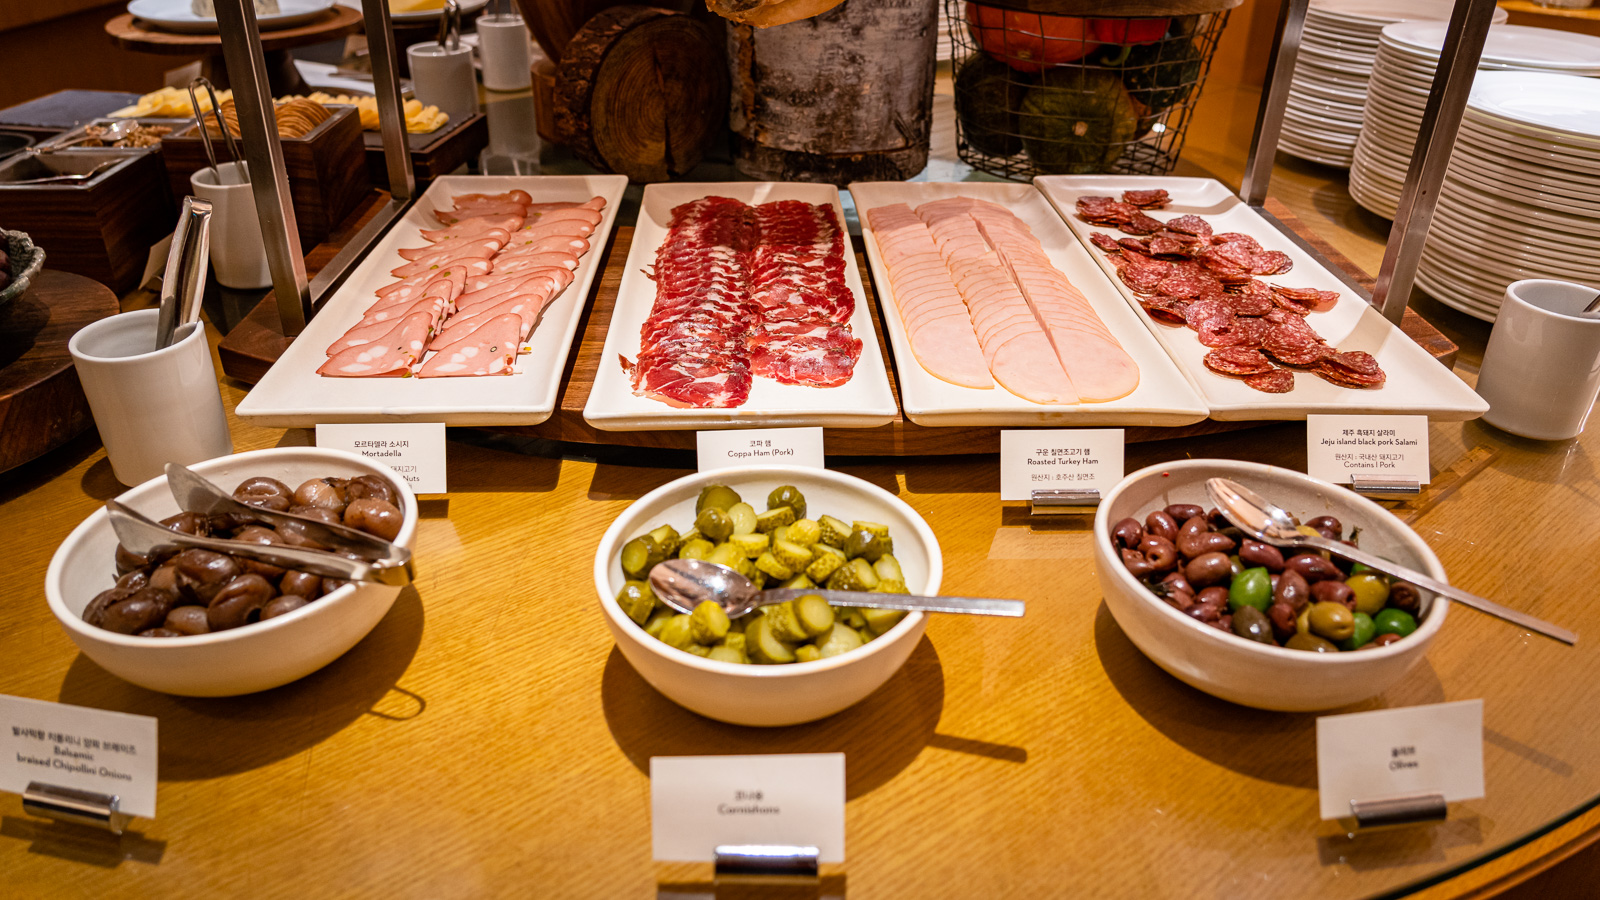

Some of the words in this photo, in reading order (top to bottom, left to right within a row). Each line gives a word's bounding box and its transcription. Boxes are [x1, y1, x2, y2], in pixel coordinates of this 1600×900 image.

[354, 440, 388, 448] 모르타델라
[388, 440, 410, 448] 소시지
[1320, 438, 1335, 446] Jeju
[1378, 438, 1394, 446] pork
[727, 450, 752, 458] Coppa
[753, 449, 770, 457] Ham
[772, 448, 794, 457] (Pork)
[1036, 448, 1048, 456] 구운
[1334, 453, 1354, 461] 원산지
[1358, 453, 1378, 461] 국내산
[1058, 458, 1081, 466] Turkey
[1031, 474, 1050, 482] 원산지
[53, 745, 95, 762] Balsamic
[16, 752, 51, 768] braised
[99, 767, 132, 782] Onions
[1388, 760, 1419, 772] Olives
